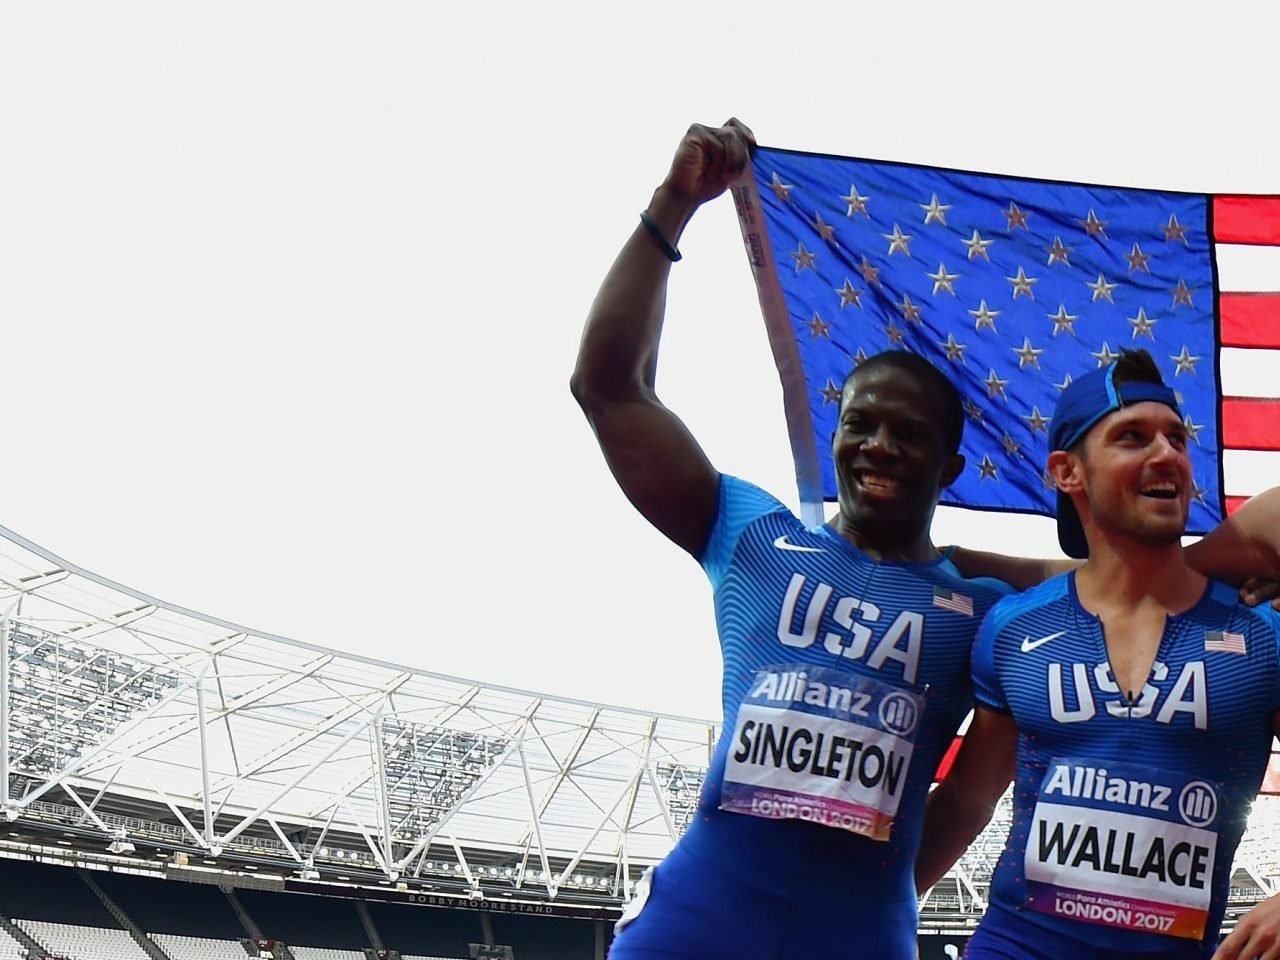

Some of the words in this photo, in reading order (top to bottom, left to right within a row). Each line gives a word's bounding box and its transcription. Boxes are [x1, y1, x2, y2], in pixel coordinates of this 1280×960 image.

[777, 573, 925, 685] USA
[752, 670, 872, 717] Allianz
[1048, 661, 1208, 730] USA
[733, 720, 905, 796] SINGLETON
[1044, 765, 1173, 812] Allianz
[751, 798, 828, 824] LONDON
[830, 811, 873, 832] 2017
[1037, 819, 1210, 890] WALLACE
[408, 894, 455, 906] BOBBY
[458, 900, 507, 911] MOORE
[510, 904, 553, 914] STAND
[1055, 899, 1131, 925] LONDON
[1134, 913, 1176, 931] 2017
